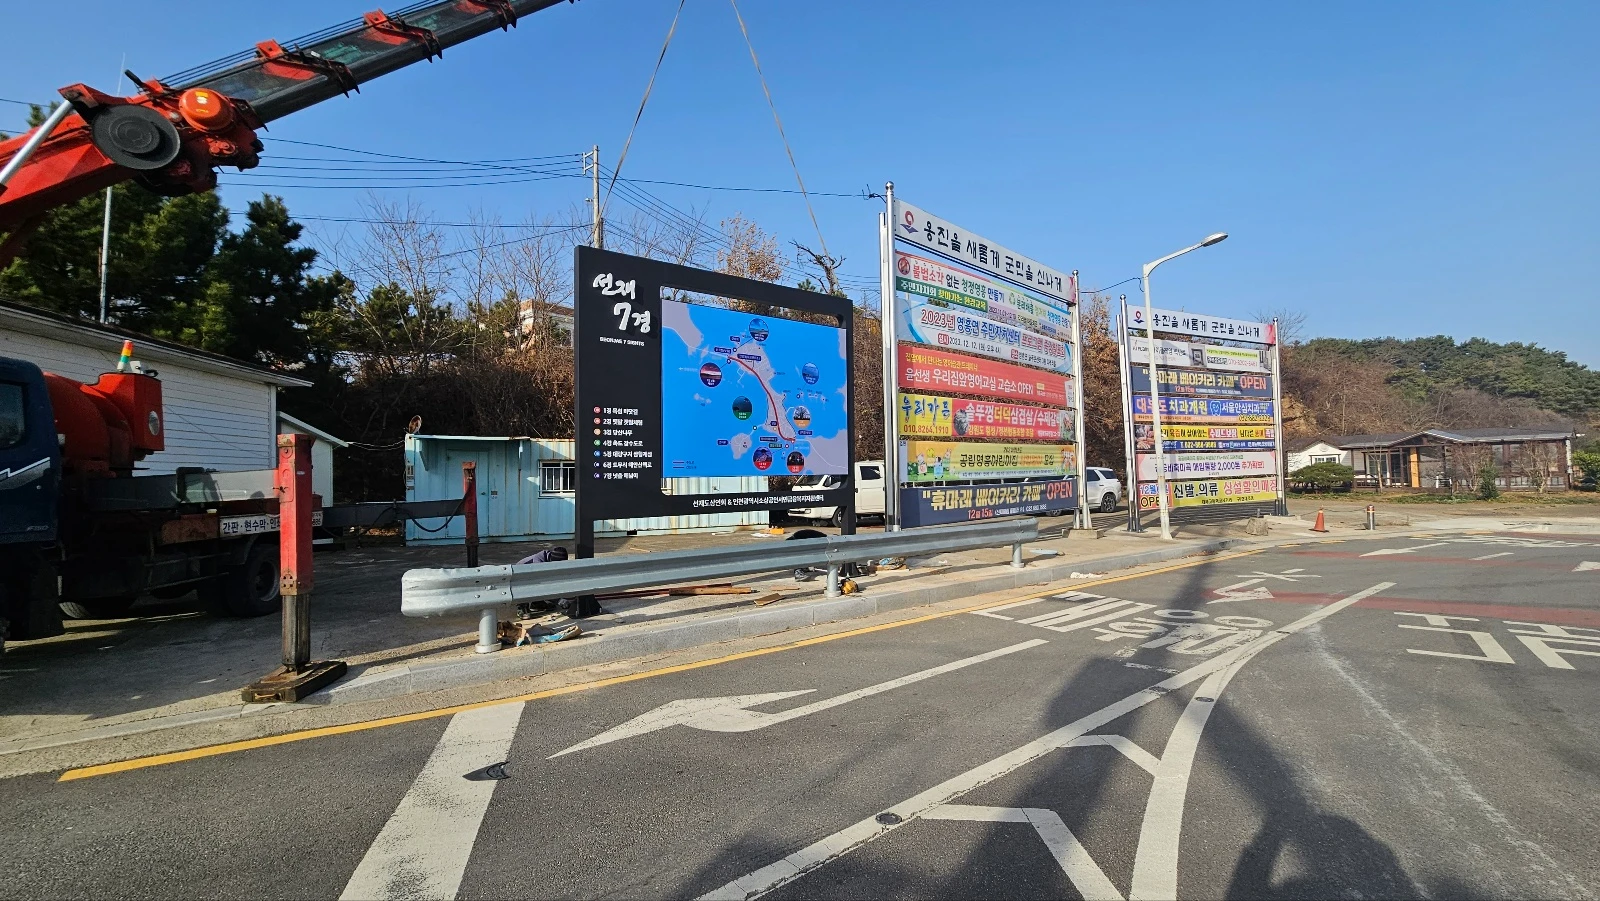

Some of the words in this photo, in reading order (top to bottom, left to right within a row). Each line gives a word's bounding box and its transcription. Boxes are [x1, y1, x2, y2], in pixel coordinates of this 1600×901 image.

[924, 220, 961, 253] 옹진을
[966, 239, 1000, 269] 새롭게
[1005, 255, 1034, 282] 군민을
[1037, 269, 1063, 293] 신나게
[593, 273, 635, 299] 선재
[901, 280, 936, 296] 주민자치회
[938, 288, 962, 303] 찾아가는
[964, 297, 986, 311] 환경교육
[913, 263, 944, 285] 불법소각
[946, 274, 959, 288] 없는
[962, 277, 986, 298] 청정영흥
[988, 287, 1004, 304] 만들기
[614, 302, 650, 333] 7경
[921, 309, 955, 330] 2023년
[957, 316, 978, 336] 영흥면
[981, 321, 1019, 344] 주민자치센터
[1153, 313, 1178, 328] 옹진을
[1182, 316, 1206, 332] 새롭게
[1211, 321, 1234, 334] 군민을
[1237, 324, 1259, 337] 신나게
[927, 356, 942, 366] 만나는
[905, 366, 929, 383] 윤선생
[932, 367, 995, 391] 우리집앞영어교실
[998, 378, 1016, 393] 교습소
[1017, 382, 1033, 394] OPEN
[1180, 371, 1215, 386] 베이커리
[1240, 376, 1266, 389] OPEN
[902, 395, 950, 422] 우리가든
[1169, 398, 1207, 414] 치과개원
[1222, 401, 1259, 413] 서울안심치과
[959, 454, 1017, 467] 공립영흥어린이집
[1044, 454, 1053, 465] 모집
[922, 487, 972, 511] "휴마레
[976, 486, 1020, 506] 베이커리
[1022, 483, 1045, 502] 카페"
[1047, 481, 1072, 500] OPEN
[1174, 481, 1218, 498] 신발.의류
